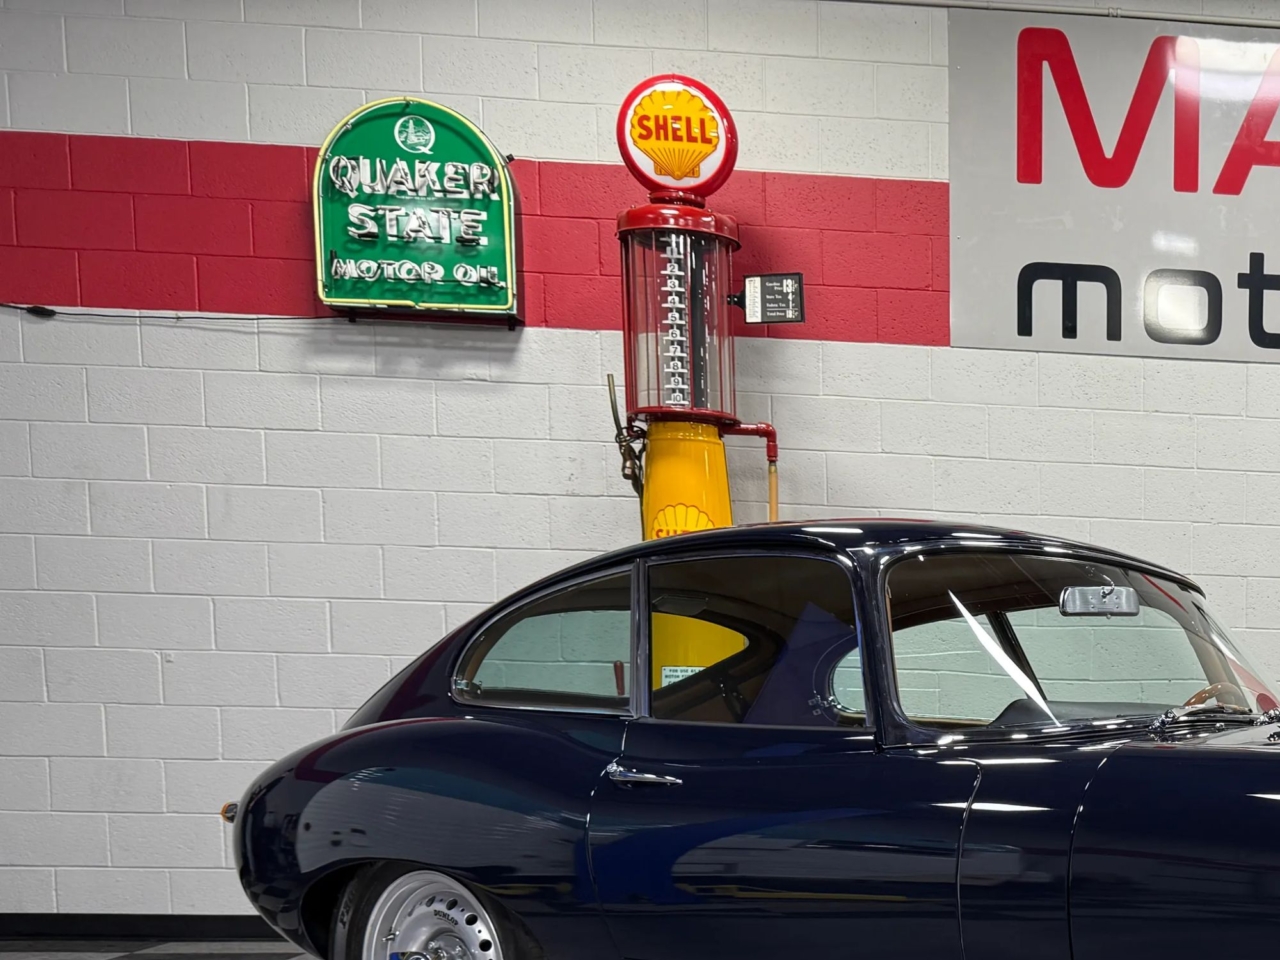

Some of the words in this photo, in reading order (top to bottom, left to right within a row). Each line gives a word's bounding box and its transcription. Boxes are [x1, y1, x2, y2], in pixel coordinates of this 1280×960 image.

[636, 114, 713, 145] SHELL
[329, 155, 501, 200] QUAKER
[347, 203, 489, 245] STATE
[669, 264, 676, 273] 2
[331, 259, 445, 284] MOTOR
[453, 263, 508, 289] OIL
[669, 280, 676, 288] 3
[671, 330, 678, 338] 6
[672, 346, 678, 354] 7
[672, 362, 679, 371] 8
[673, 378, 680, 386] 9
[673, 394, 682, 402] 10
[433, 909, 459, 926] DUNLOP
